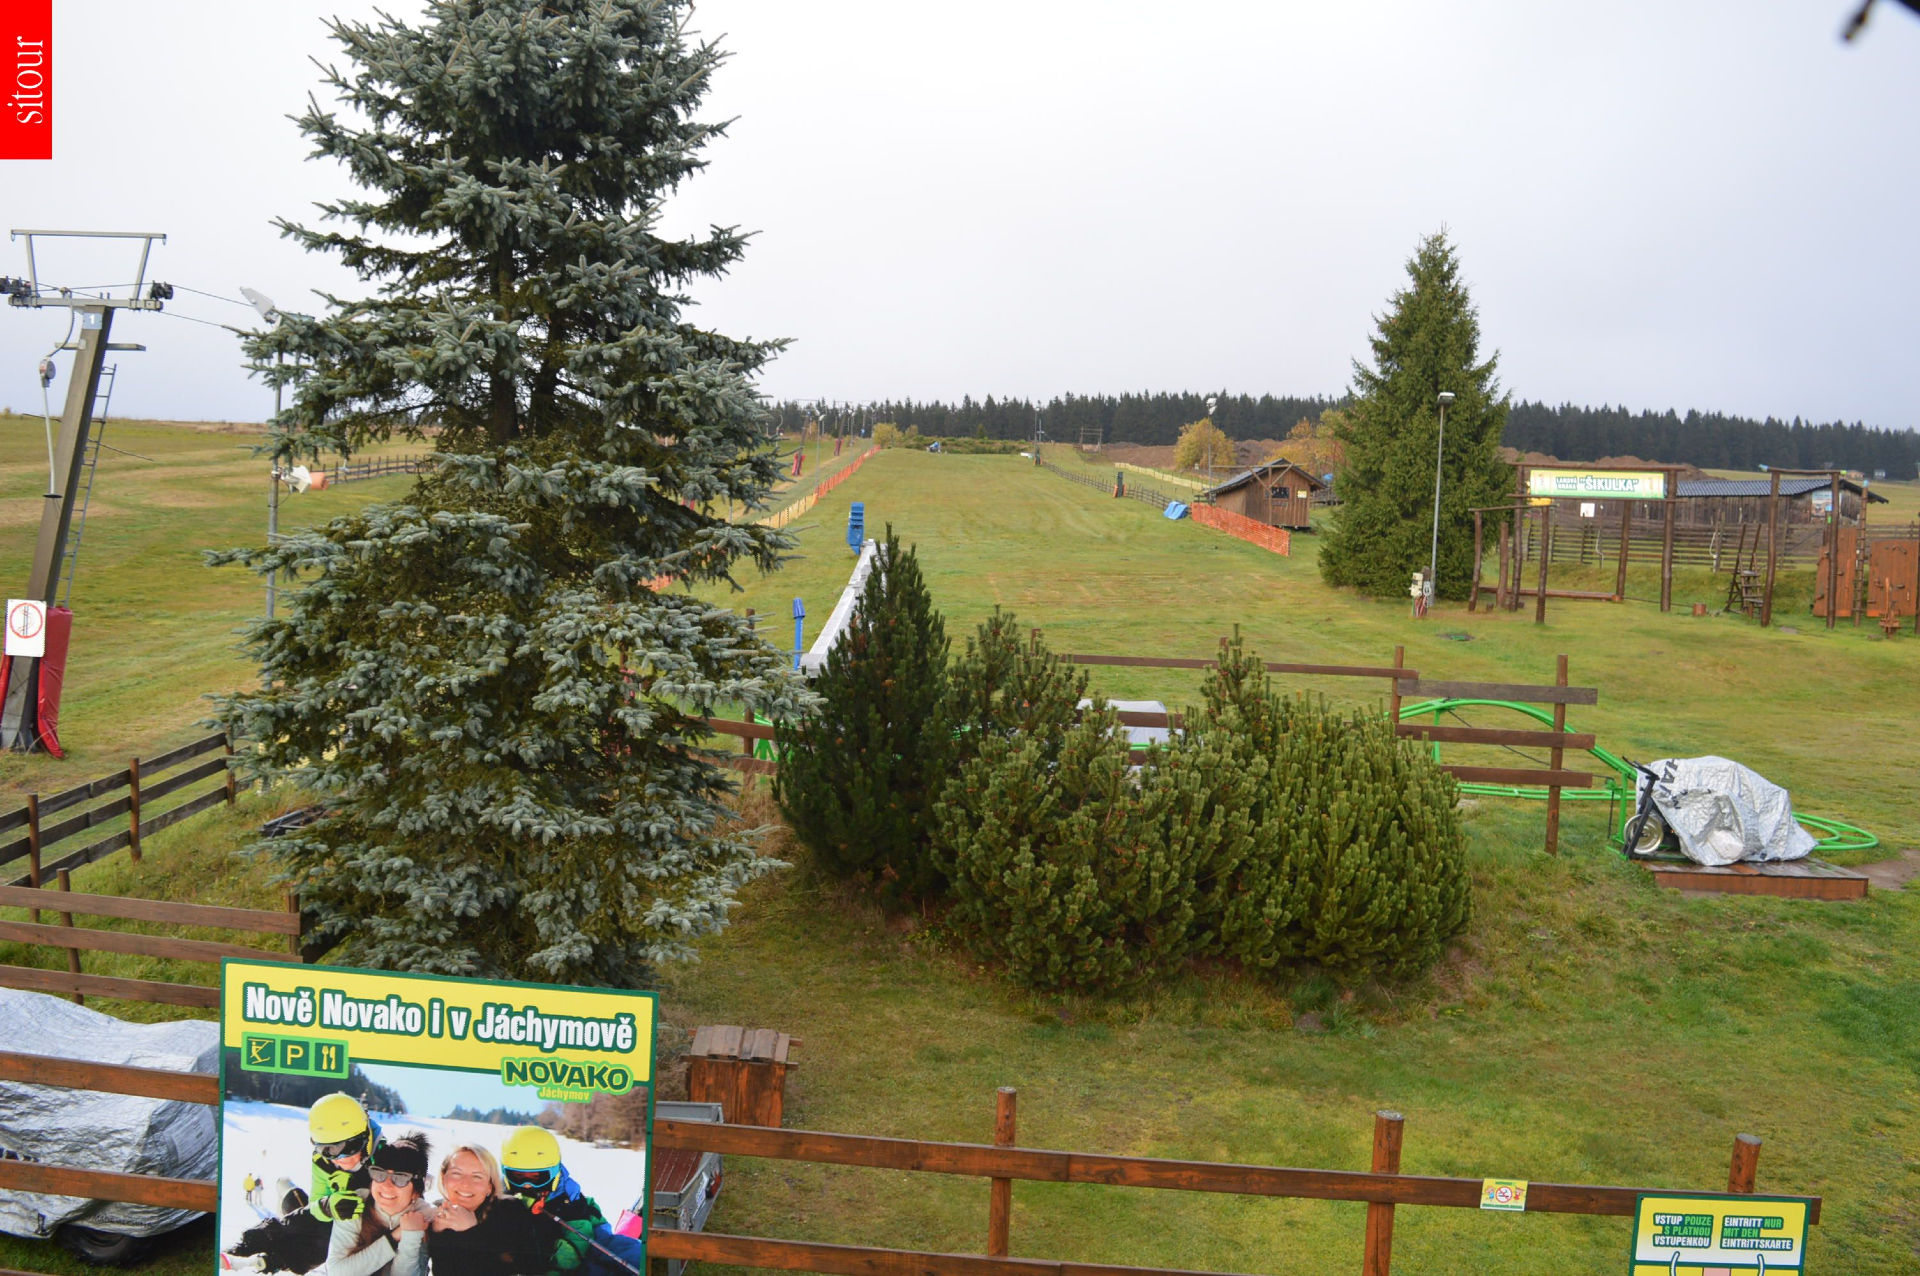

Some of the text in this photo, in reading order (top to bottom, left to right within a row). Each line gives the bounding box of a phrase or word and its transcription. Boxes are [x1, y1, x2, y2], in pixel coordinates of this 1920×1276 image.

[88, 314, 96, 325] 1
[246, 986, 633, 1050] Nově Novako i v Jáchymově
[286, 1044, 304, 1066] P
[505, 1060, 629, 1091] NOVAKO
[539, 1087, 590, 1101] Jáchymov
[1654, 1214, 1712, 1226] VSTUP POUZE
[1724, 1216, 1782, 1228] EINTRITT NUR
[1664, 1226, 1711, 1237] S PLATNOU
[1723, 1227, 1759, 1238] MIT DEN
[1654, 1236, 1710, 1248] VSTUPENKOU
[1721, 1238, 1792, 1250] EINTRITTSKARTE
